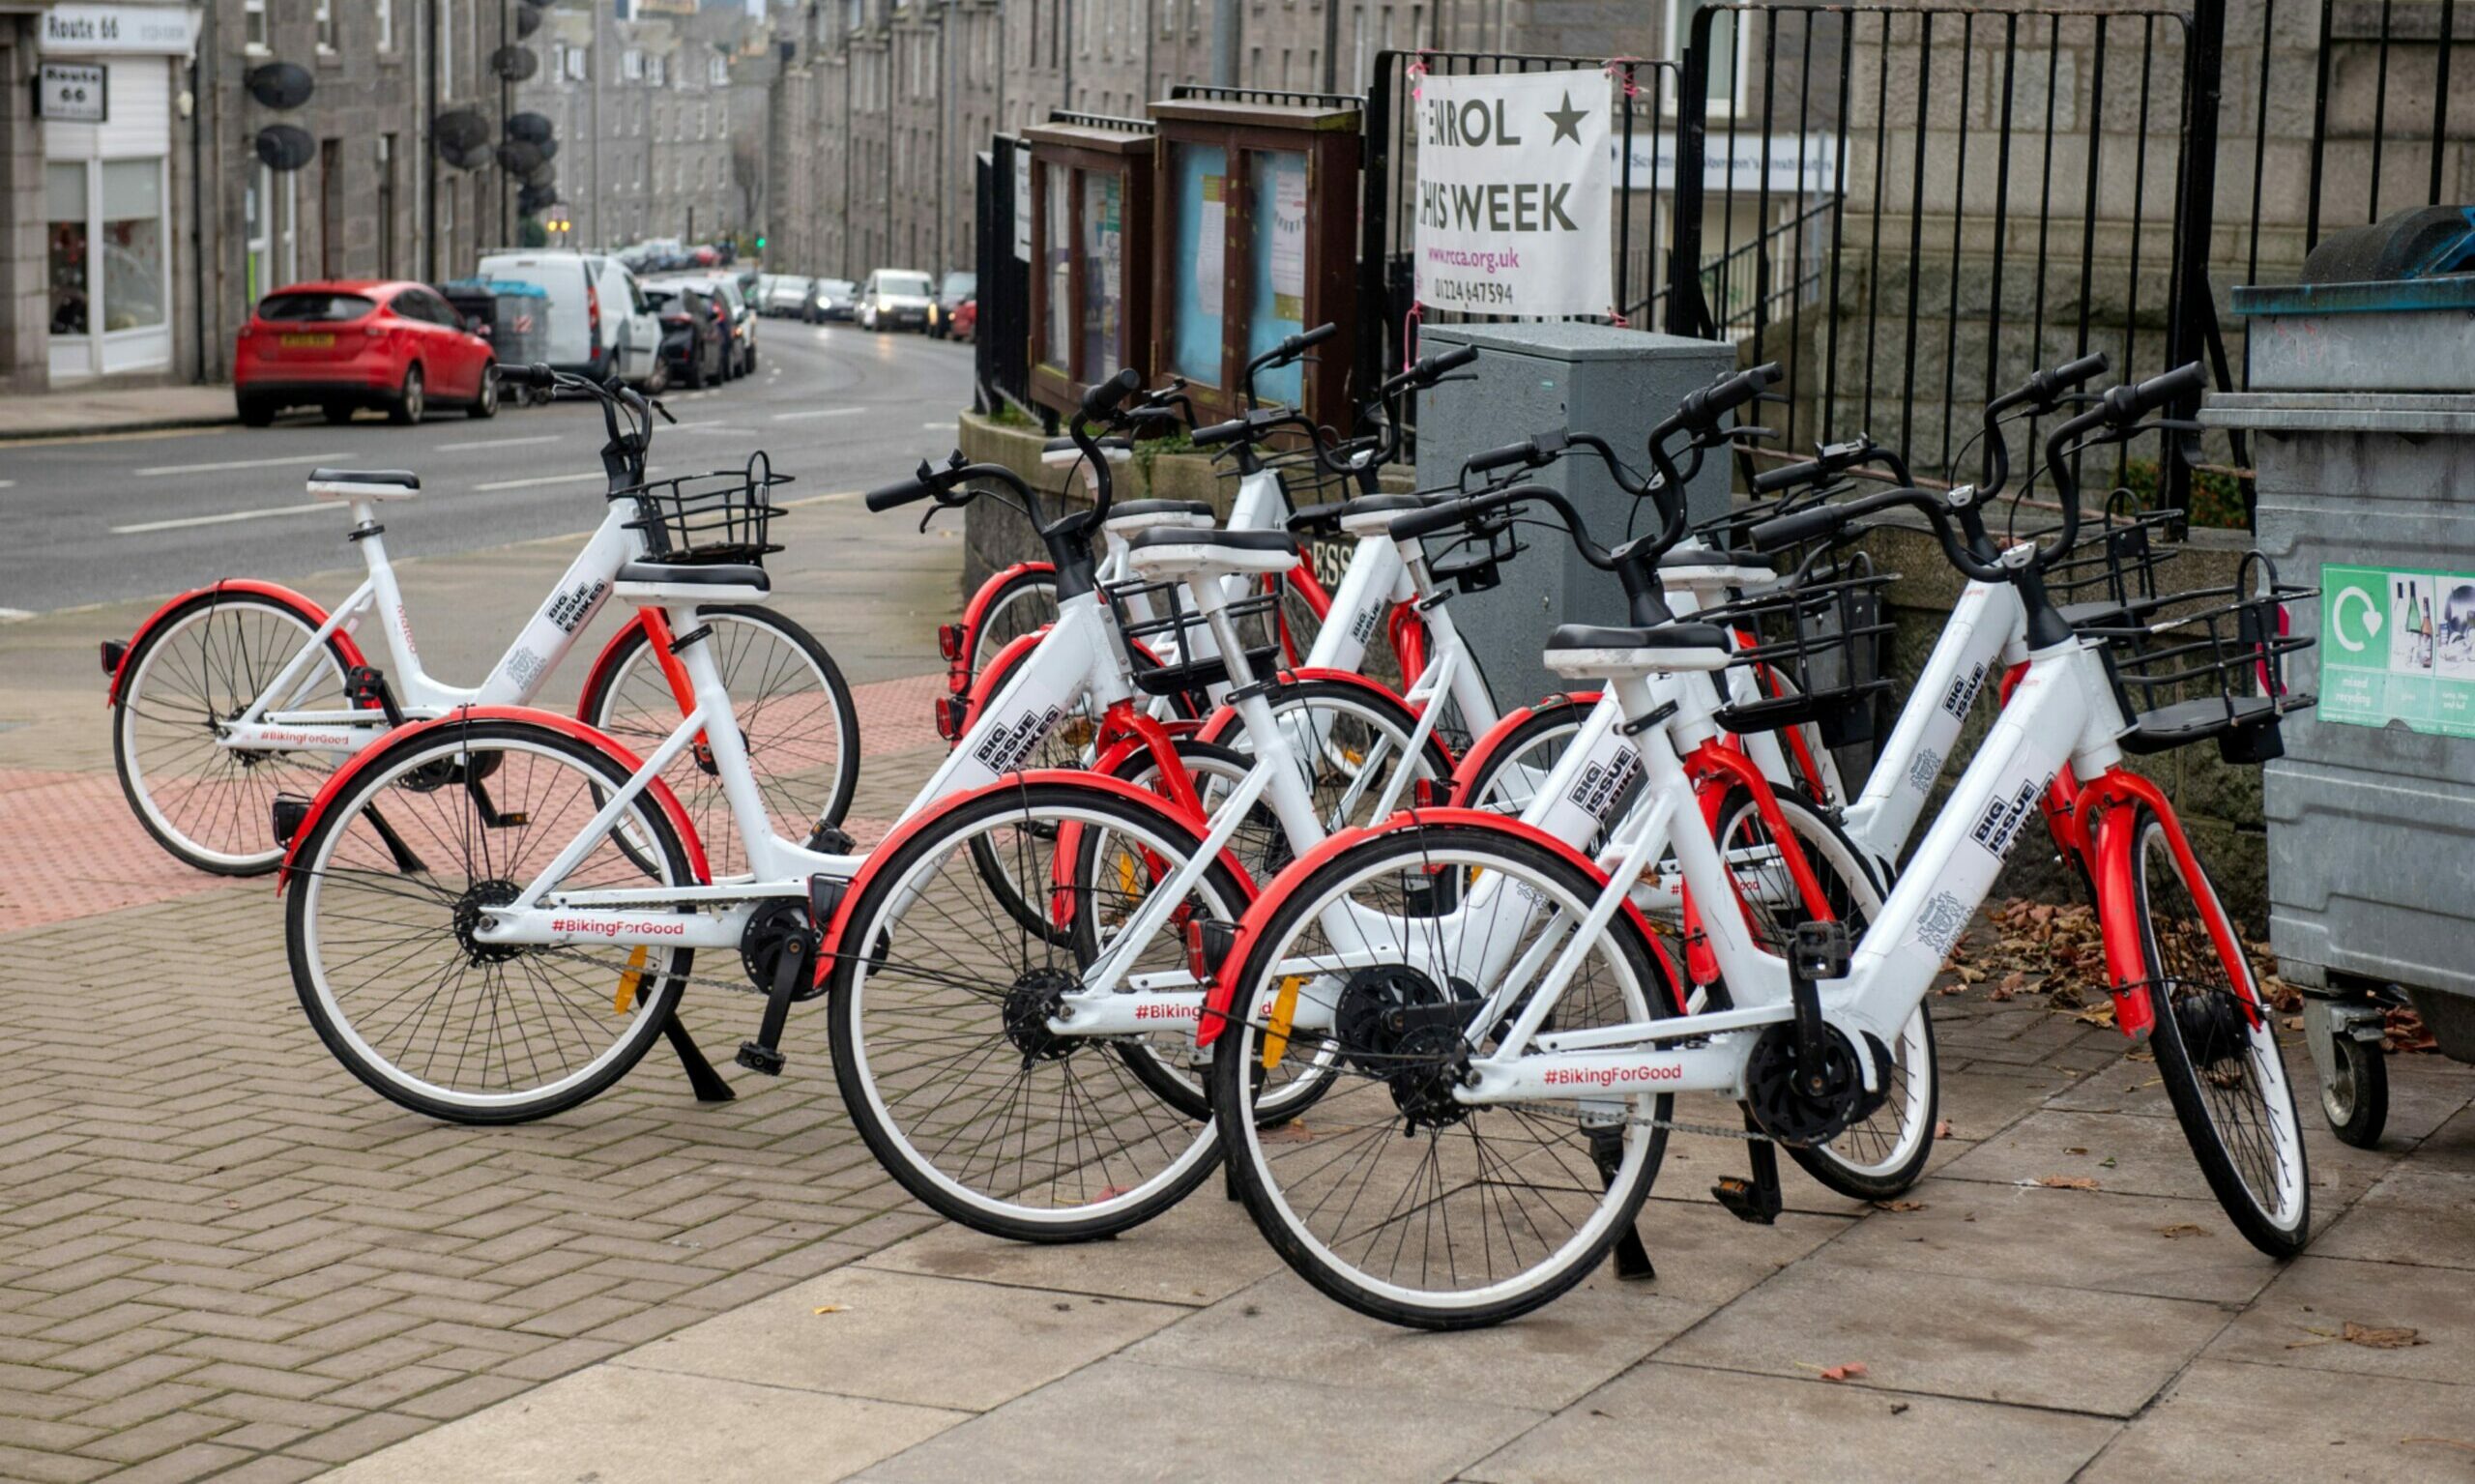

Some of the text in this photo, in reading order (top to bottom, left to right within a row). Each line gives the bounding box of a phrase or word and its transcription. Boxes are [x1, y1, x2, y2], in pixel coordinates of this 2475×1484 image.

[48, 15, 95, 40] Route
[101, 16, 120, 40] 66
[1450, 183, 1579, 232] WEEK
[547, 595, 568, 619] BIG
[556, 585, 589, 626] ISSUE
[565, 582, 605, 633] E-BIKES
[1353, 611, 1367, 637] BIG
[1360, 602, 1382, 645] ISSUE
[1945, 680, 1965, 711] BIG
[1955, 666, 1984, 718] ISSUE
[260, 731, 349, 745] #BikingForGood
[976, 727, 1007, 761] BIG
[989, 713, 1037, 771] ISSUE
[1571, 767, 1602, 803] BIG
[1586, 749, 1632, 814] ISSUE
[1974, 800, 2006, 842] BIG
[1989, 784, 2036, 853] ISSUE
[551, 918, 684, 937] #BikingForGood
[1544, 1064, 1682, 1087] #BikingForGood
